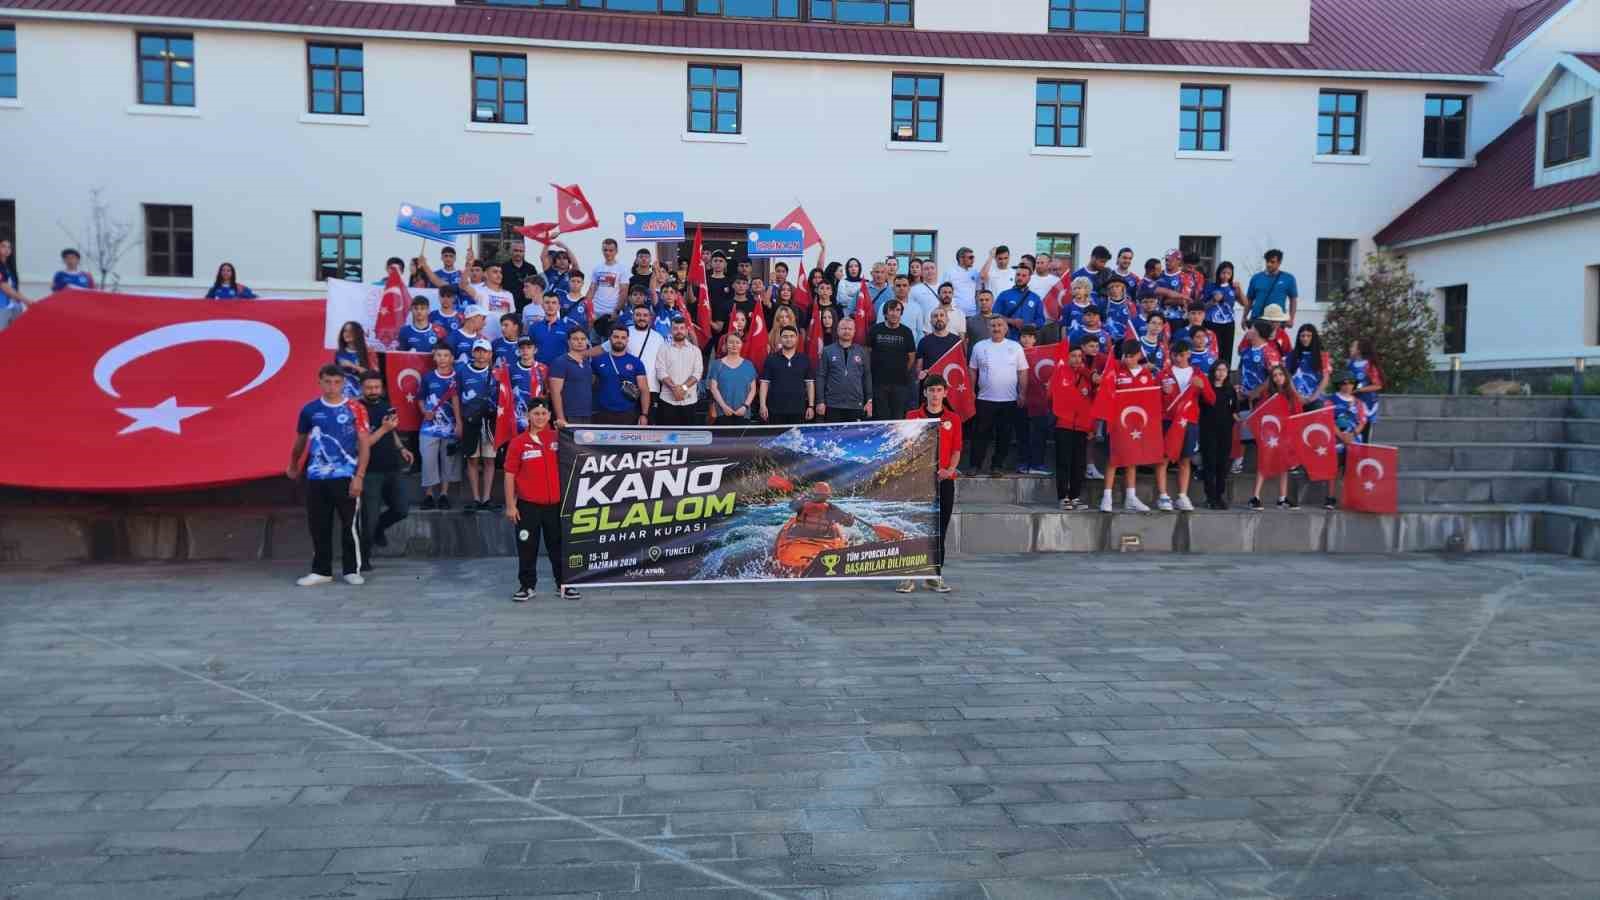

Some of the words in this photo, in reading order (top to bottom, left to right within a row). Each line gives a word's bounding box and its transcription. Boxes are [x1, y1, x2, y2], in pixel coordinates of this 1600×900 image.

[580, 447, 689, 475] AKARSU
[575, 462, 738, 508] KANO
[570, 491, 737, 534] SLALOM
[599, 529, 647, 544] BAHAR
[654, 522, 707, 537] KUPASI
[665, 544, 695, 557] TUNCELİ
[846, 551, 860, 562] TÜM
[860, 547, 900, 561] SPORCULARA
[588, 560, 618, 571] HAZİRAN
[844, 560, 886, 575] BAŞARILAR
[887, 554, 928, 567] DİLİYORUM
